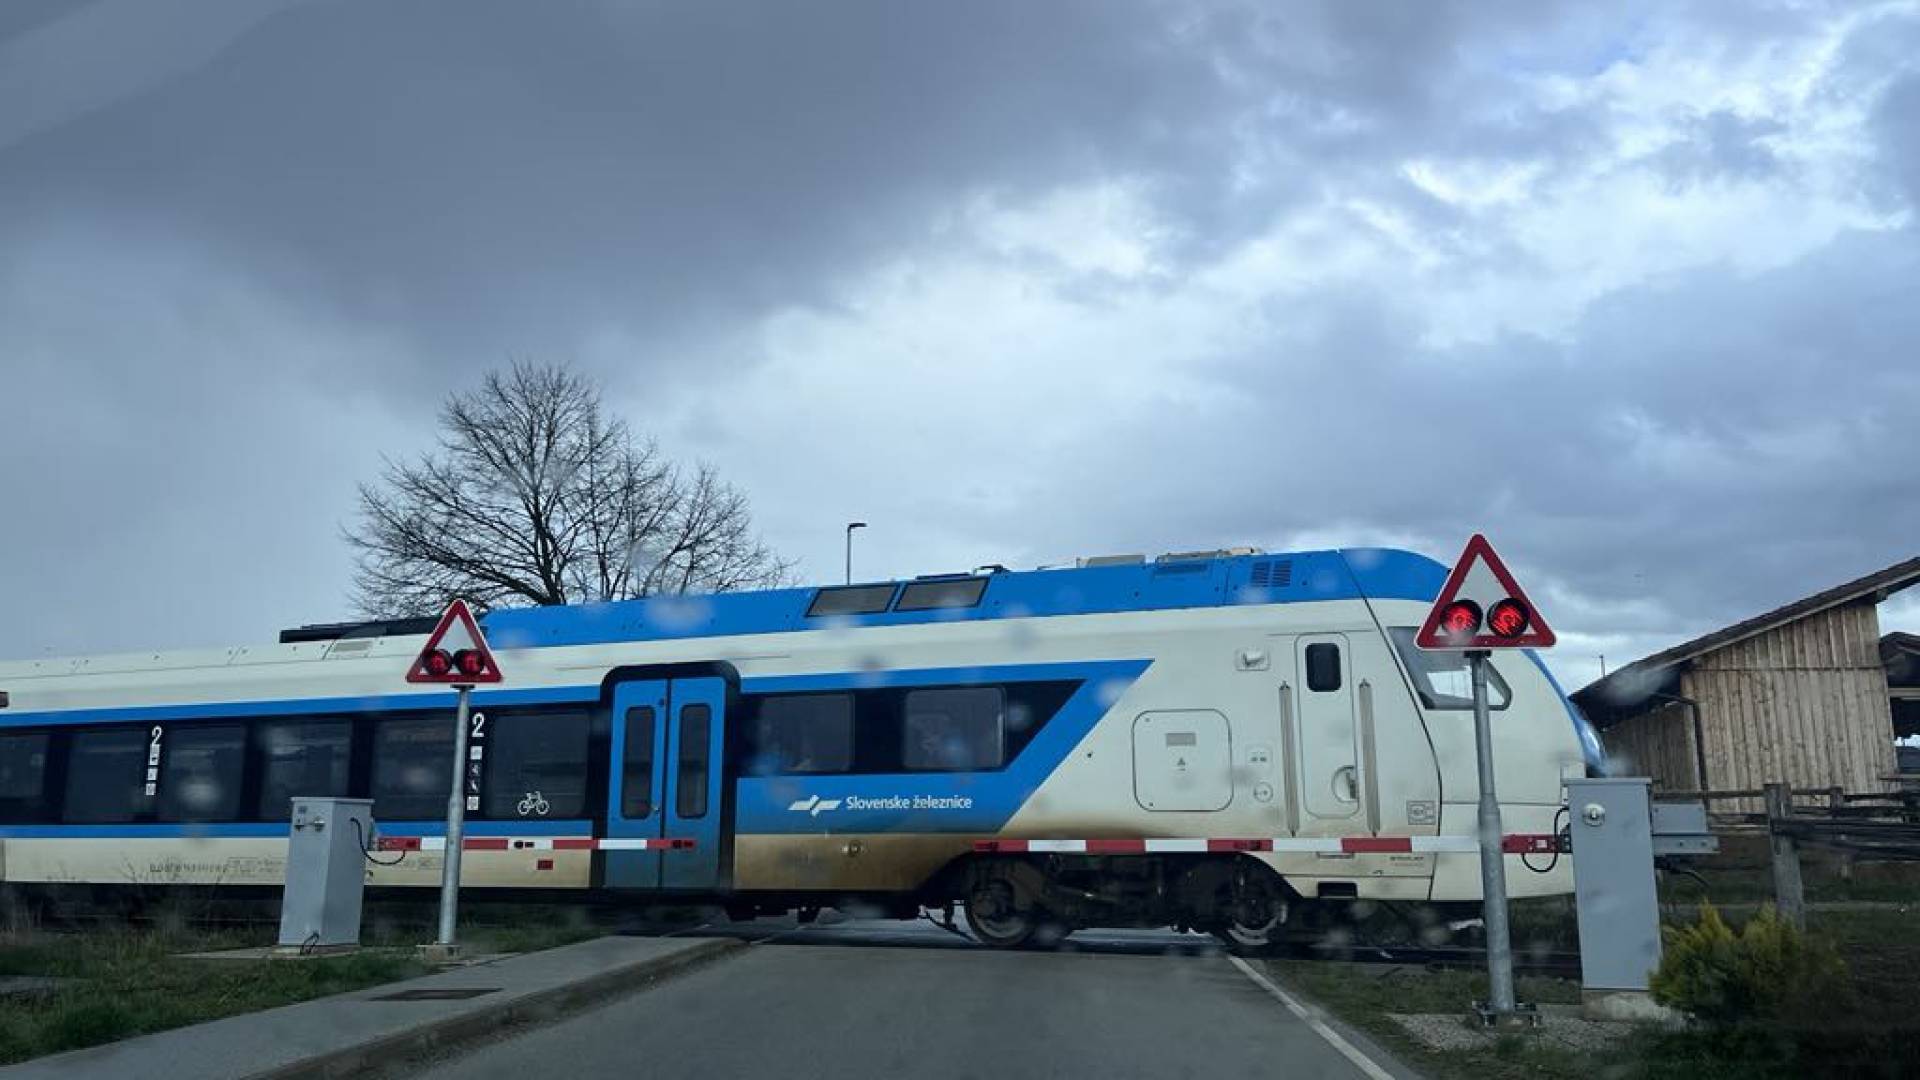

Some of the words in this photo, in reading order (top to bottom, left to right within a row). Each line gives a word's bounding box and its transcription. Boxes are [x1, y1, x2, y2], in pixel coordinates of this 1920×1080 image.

[472, 712, 484, 737] 2
[151, 725, 162, 746] 2
[846, 794, 909, 809] Slovenske
[912, 794, 972, 809] železnice
